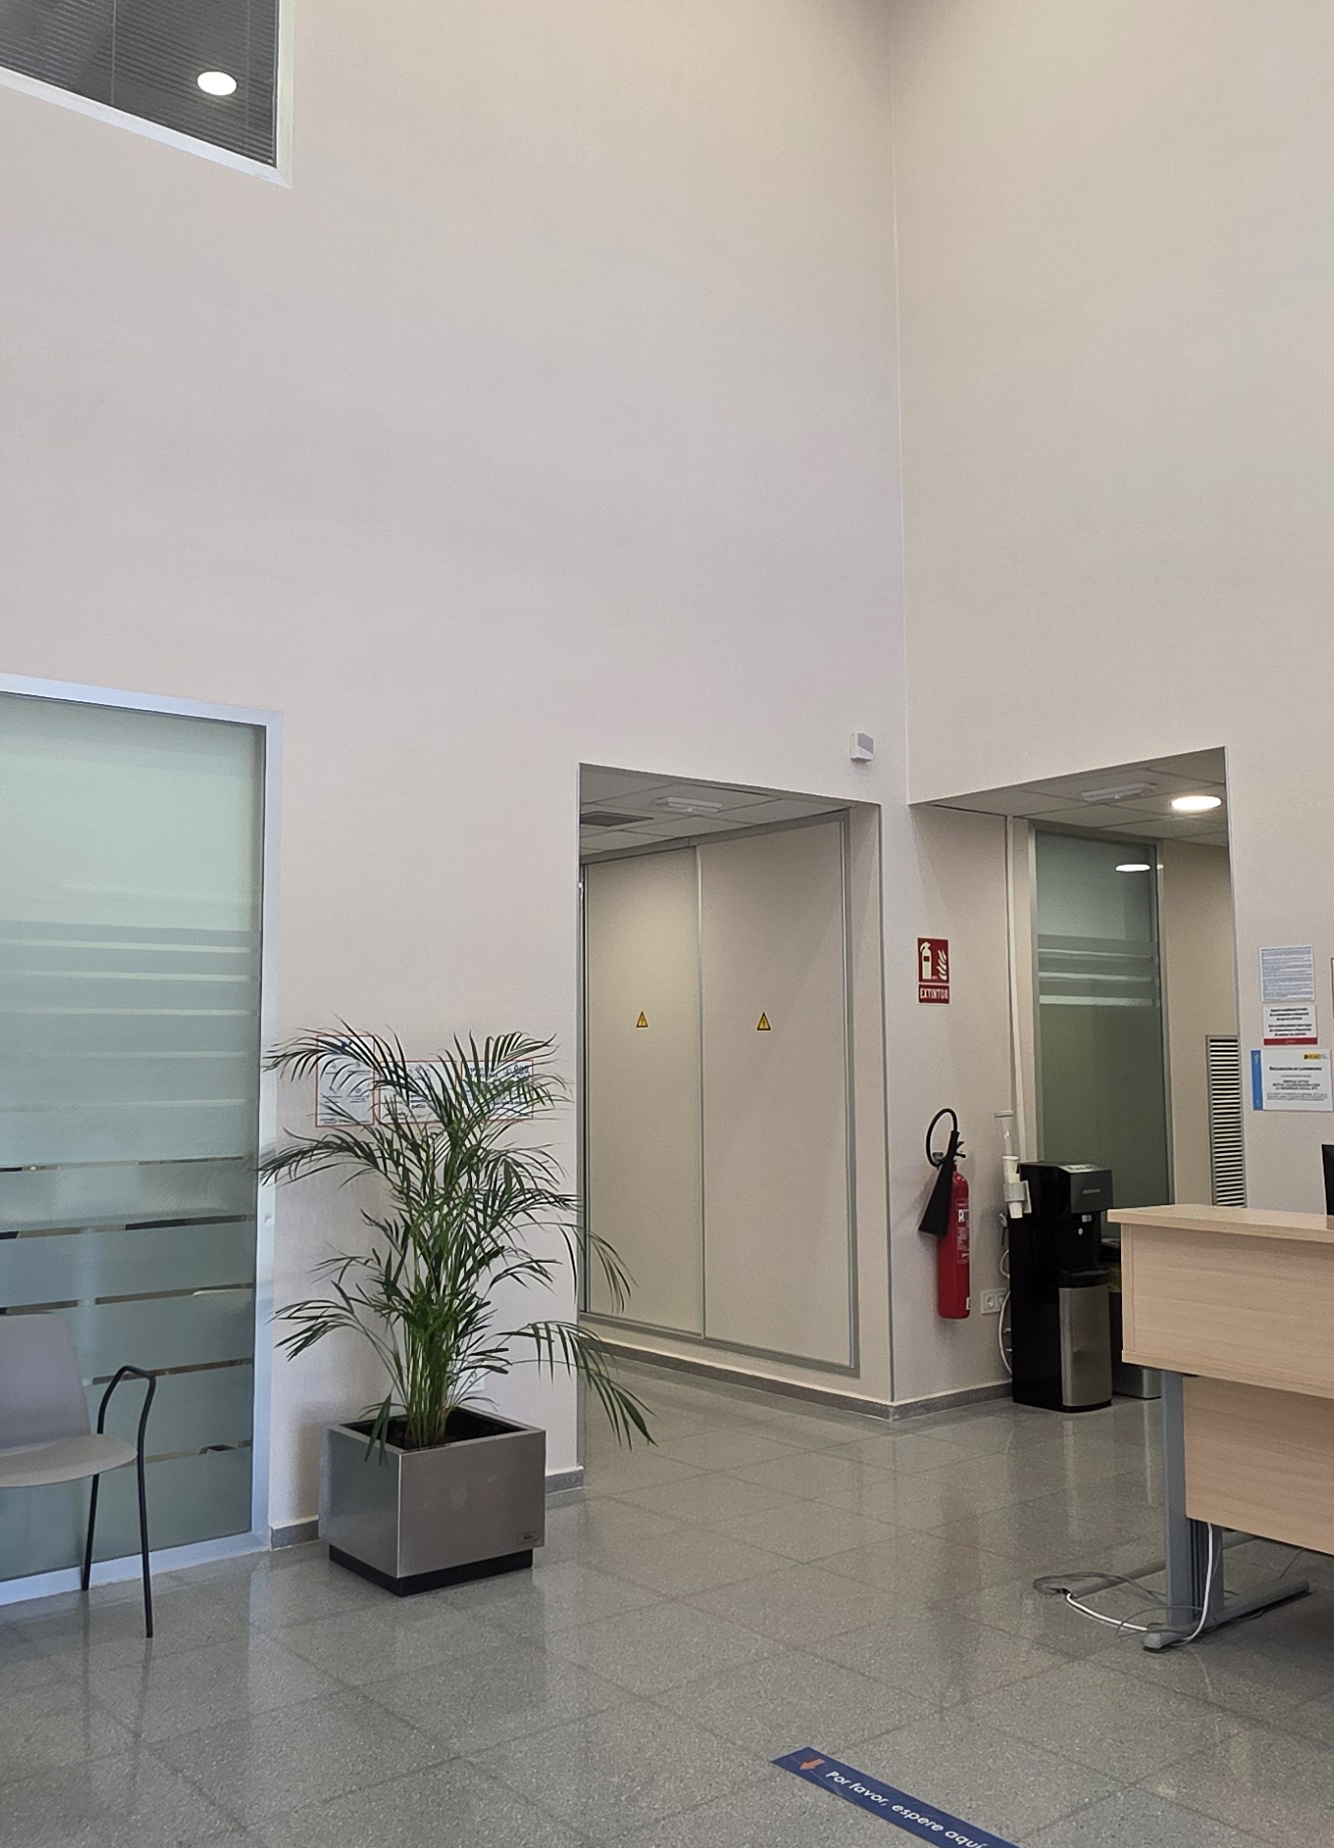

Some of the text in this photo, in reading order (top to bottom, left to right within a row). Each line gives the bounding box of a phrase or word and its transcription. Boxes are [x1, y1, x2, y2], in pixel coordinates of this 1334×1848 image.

[920, 988, 949, 999] EXTINTOR
[825, 1771, 851, 1785] Por
[848, 1782, 889, 1806] favor,
[891, 1803, 944, 1832] espere
